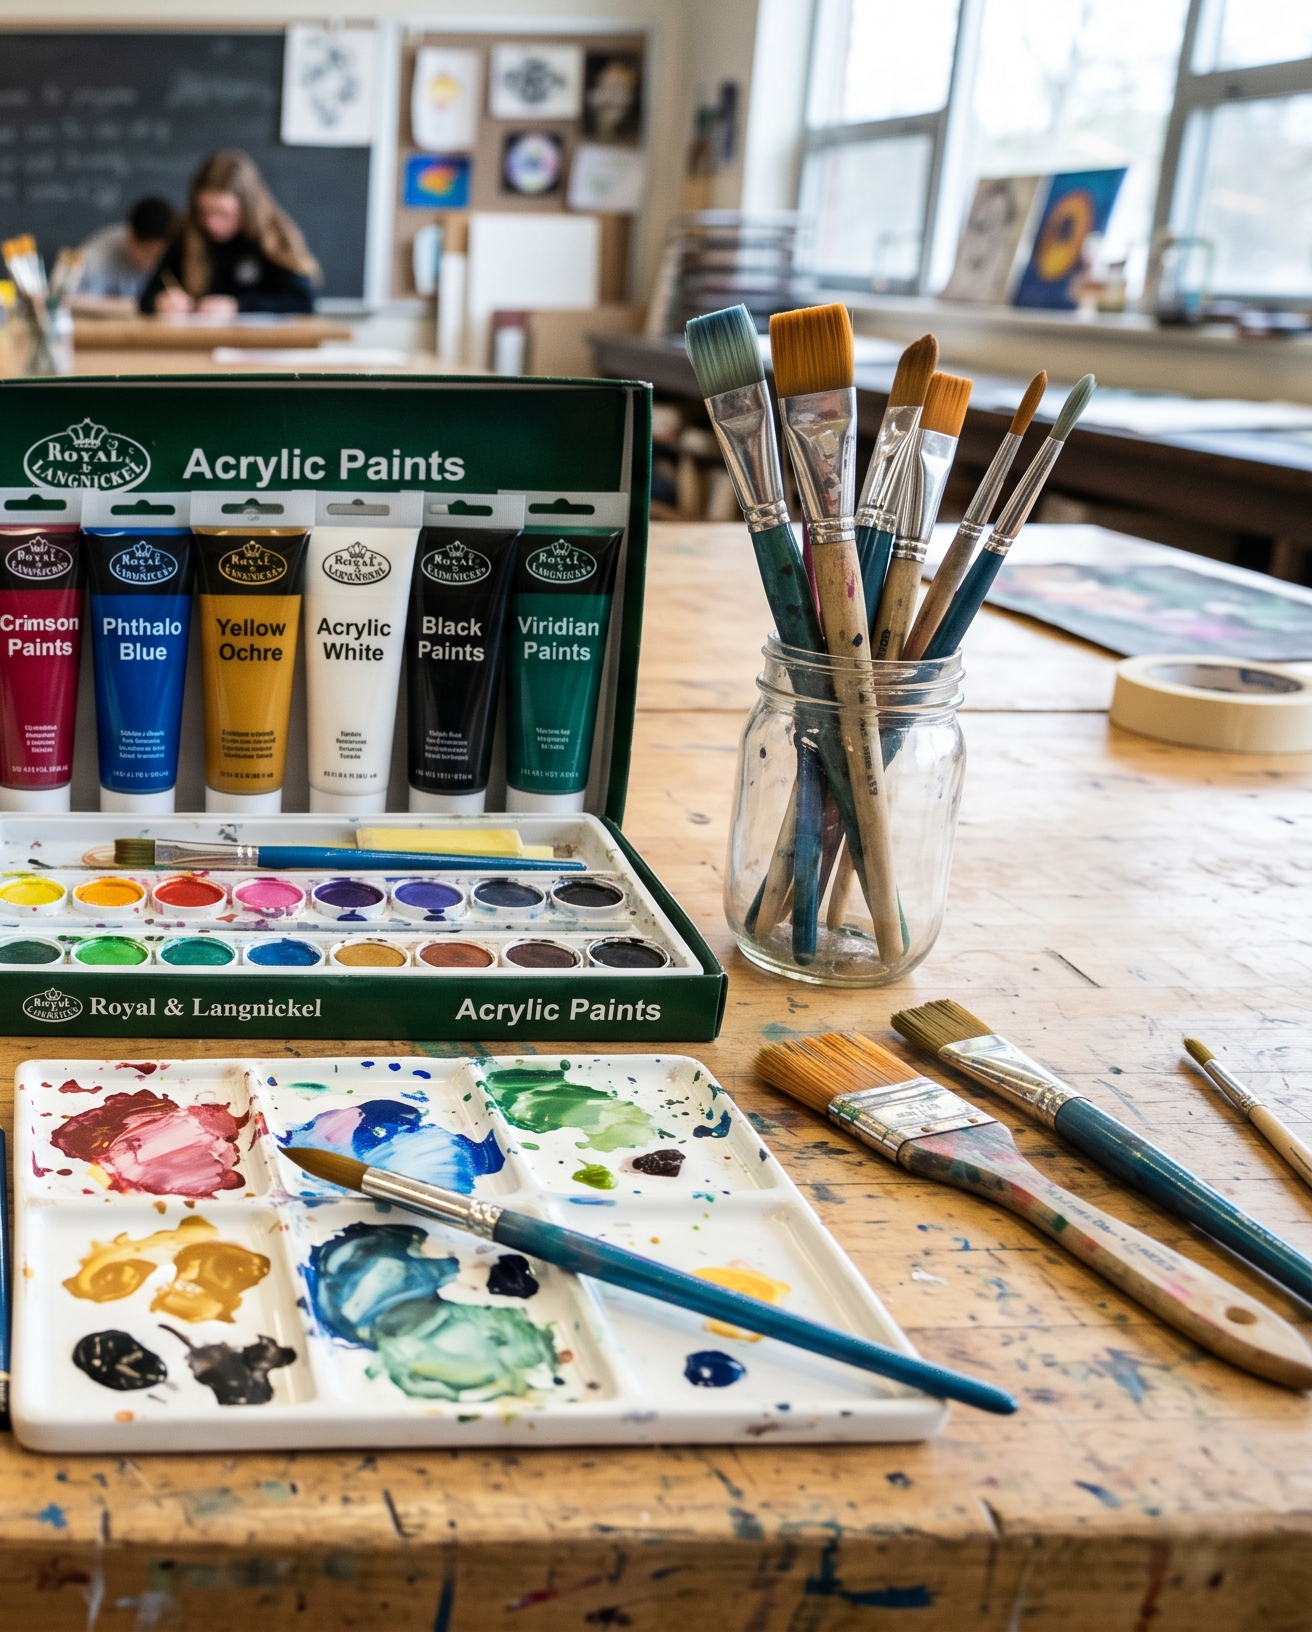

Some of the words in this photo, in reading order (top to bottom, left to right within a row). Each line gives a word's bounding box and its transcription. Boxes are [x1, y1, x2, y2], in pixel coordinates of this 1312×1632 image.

[183, 448, 325, 488] Acrylic
[340, 448, 465, 481] Paints
[0, 613, 79, 631] Crimson
[103, 617, 182, 635] Phthalo
[216, 618, 287, 637] Yellow
[316, 618, 392, 641] Acrylic
[422, 616, 482, 637] Black
[517, 616, 600, 637] Viridian
[8, 638, 73, 656] Paints
[119, 643, 168, 661] Blue
[219, 643, 283, 661] Ochre
[322, 643, 385, 661] White
[418, 641, 485, 662] Paints
[523, 641, 591, 661] Paints
[89, 997, 157, 1020] Royal
[163, 997, 185, 1016] &
[192, 998, 322, 1021] Langnickel
[454, 998, 560, 1026] Acrylic
[569, 998, 662, 1021] Paints
